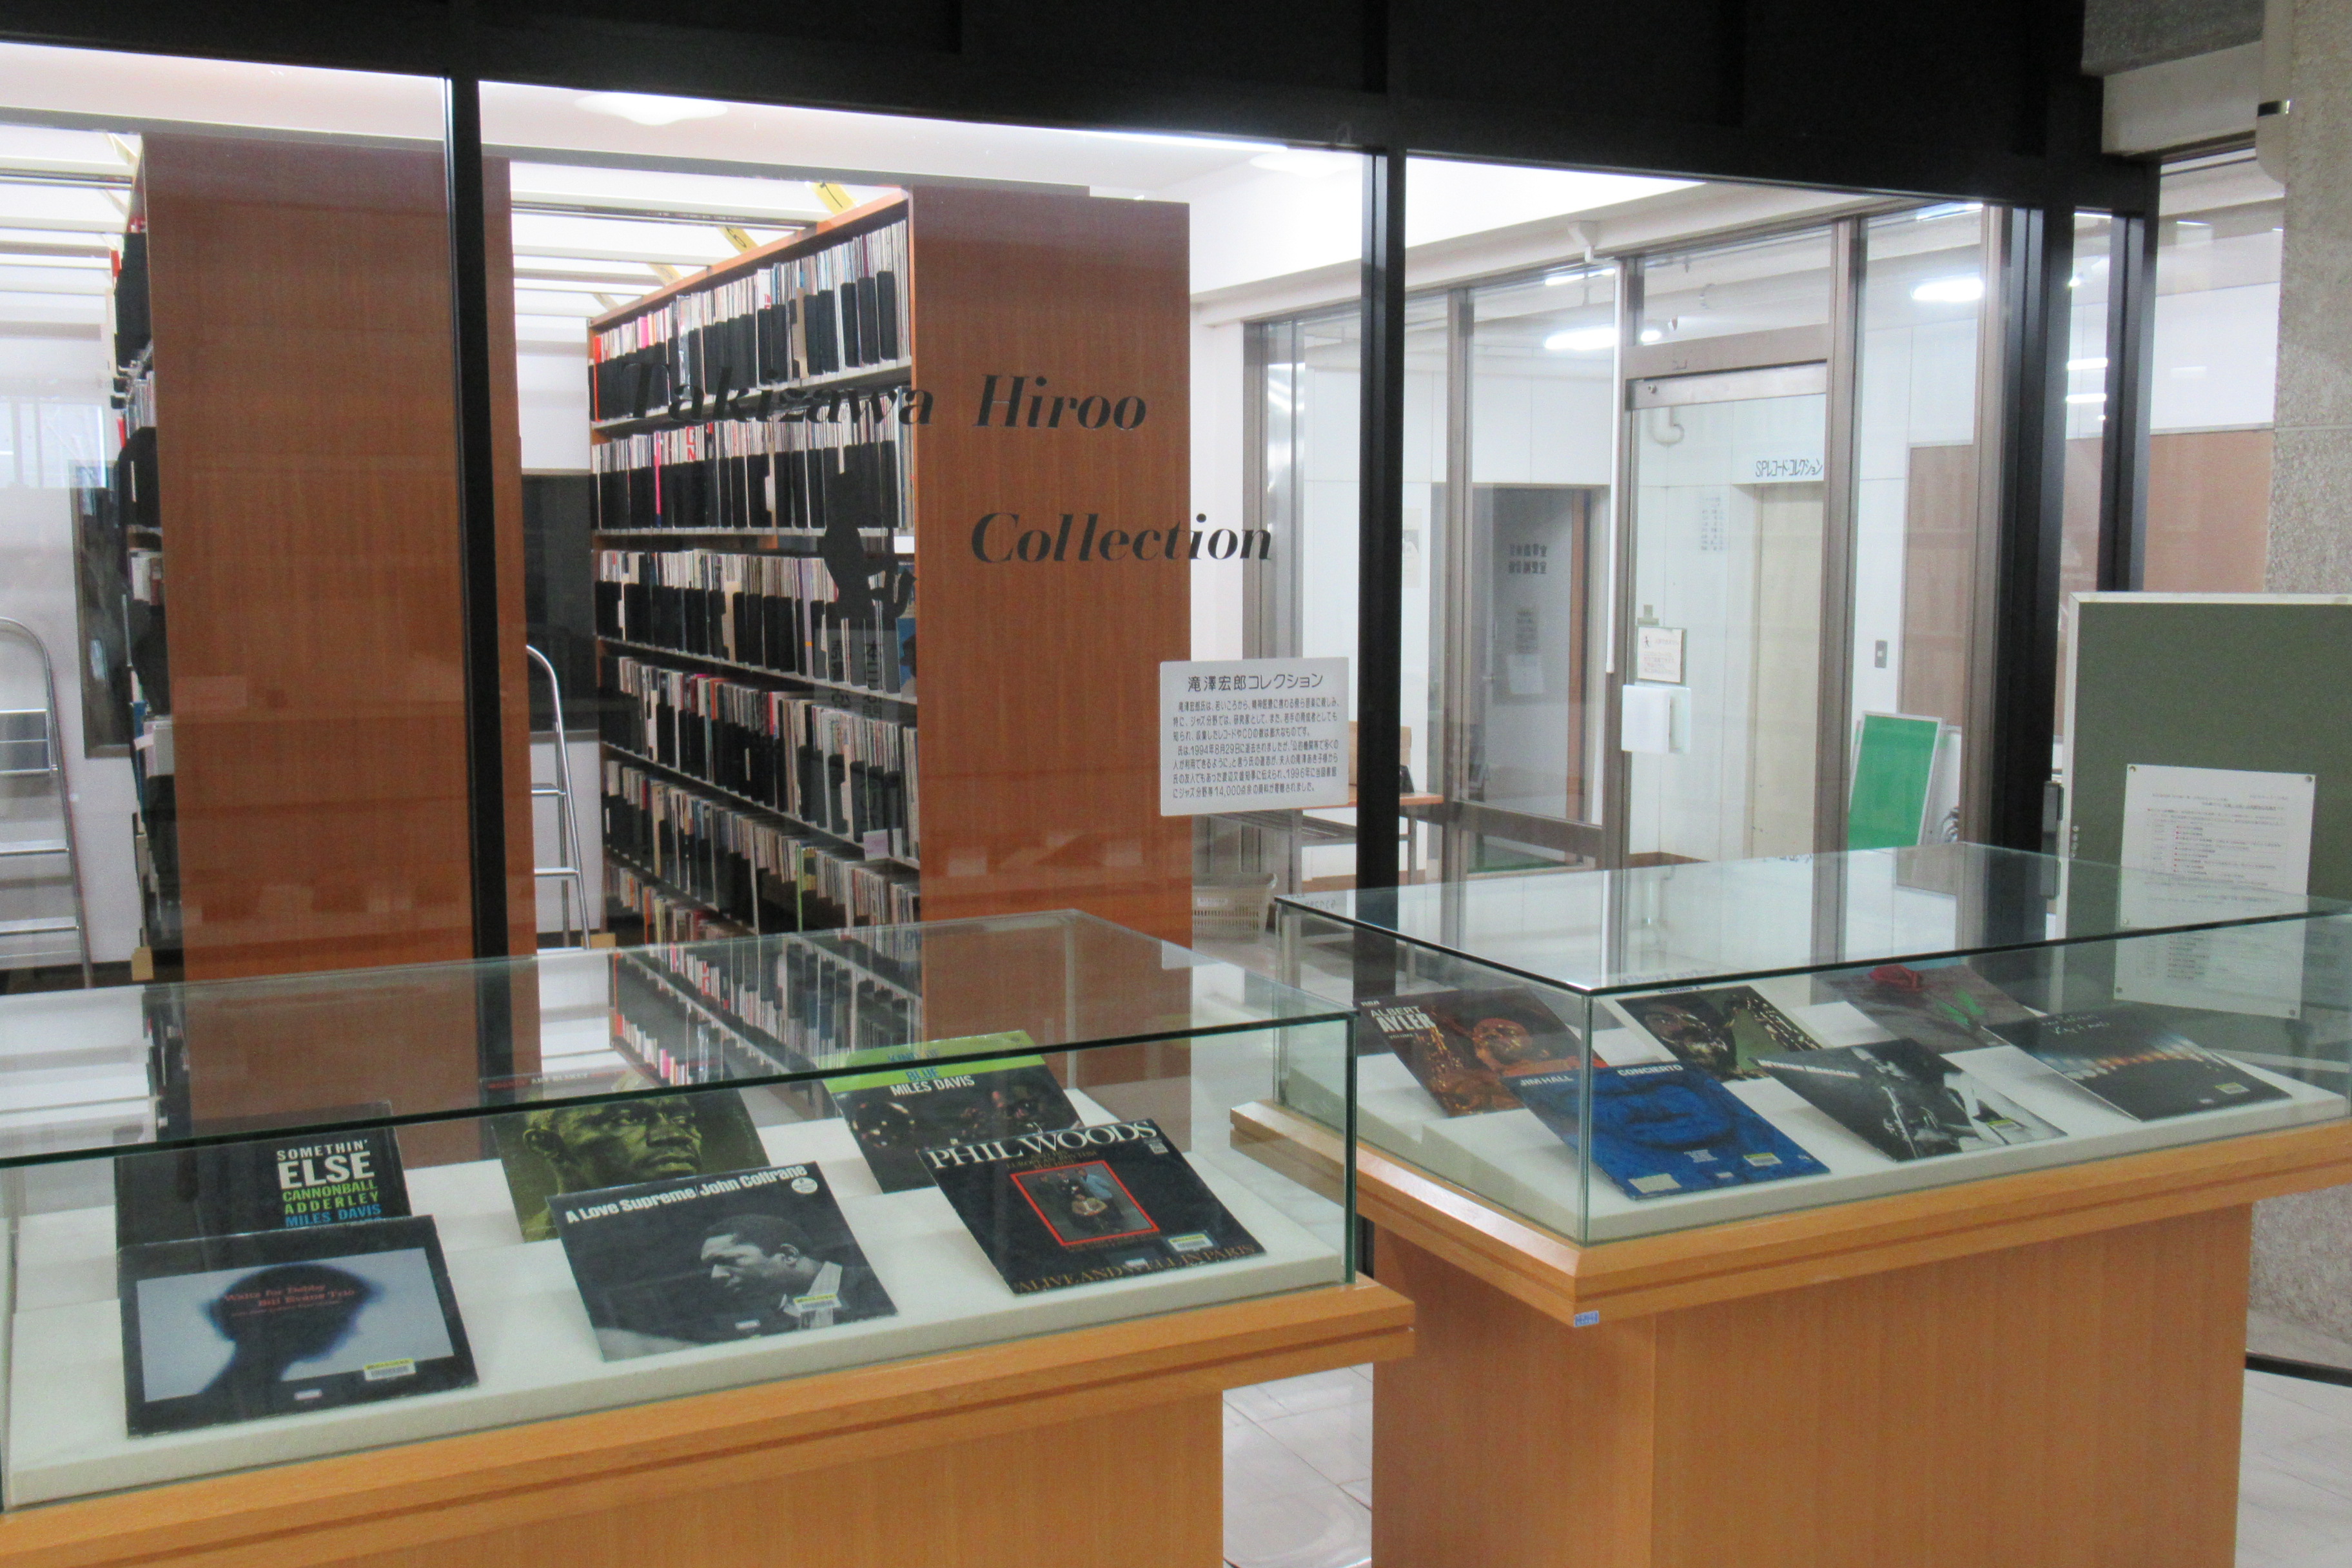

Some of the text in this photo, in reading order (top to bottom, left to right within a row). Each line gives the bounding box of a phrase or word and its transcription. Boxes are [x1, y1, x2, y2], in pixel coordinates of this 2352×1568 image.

[972, 374, 1146, 430] Hiroo
[971, 512, 1272, 563] Collection
[1188, 673, 1324, 692] 滝澤宏郎コレクション
[1371, 1006, 1421, 1018] ALBERT
[1376, 1012, 1437, 1032] AYLER
[905, 1066, 941, 1081] BLUE
[1520, 1075, 1574, 1086] JIM HALL
[1617, 1064, 1683, 1077] CONCIERTO
[890, 1075, 975, 1096] MILES DAVIS
[277, 1139, 368, 1161] SOMETHIN'
[928, 1141, 1024, 1169] PHIL
[1018, 1121, 1157, 1155] WOODS
[278, 1150, 375, 1190] ELSE
[282, 1179, 378, 1202] CANNONBALL
[565, 1210, 580, 1224] A
[580, 1201, 620, 1220] Love
[740, 1164, 808, 1188] Coltrane
[285, 1191, 379, 1215] ADDERLEY
[286, 1211, 332, 1228] MILES
[338, 1203, 382, 1220] DAVIS
[1081, 1266, 1124, 1283] AND
